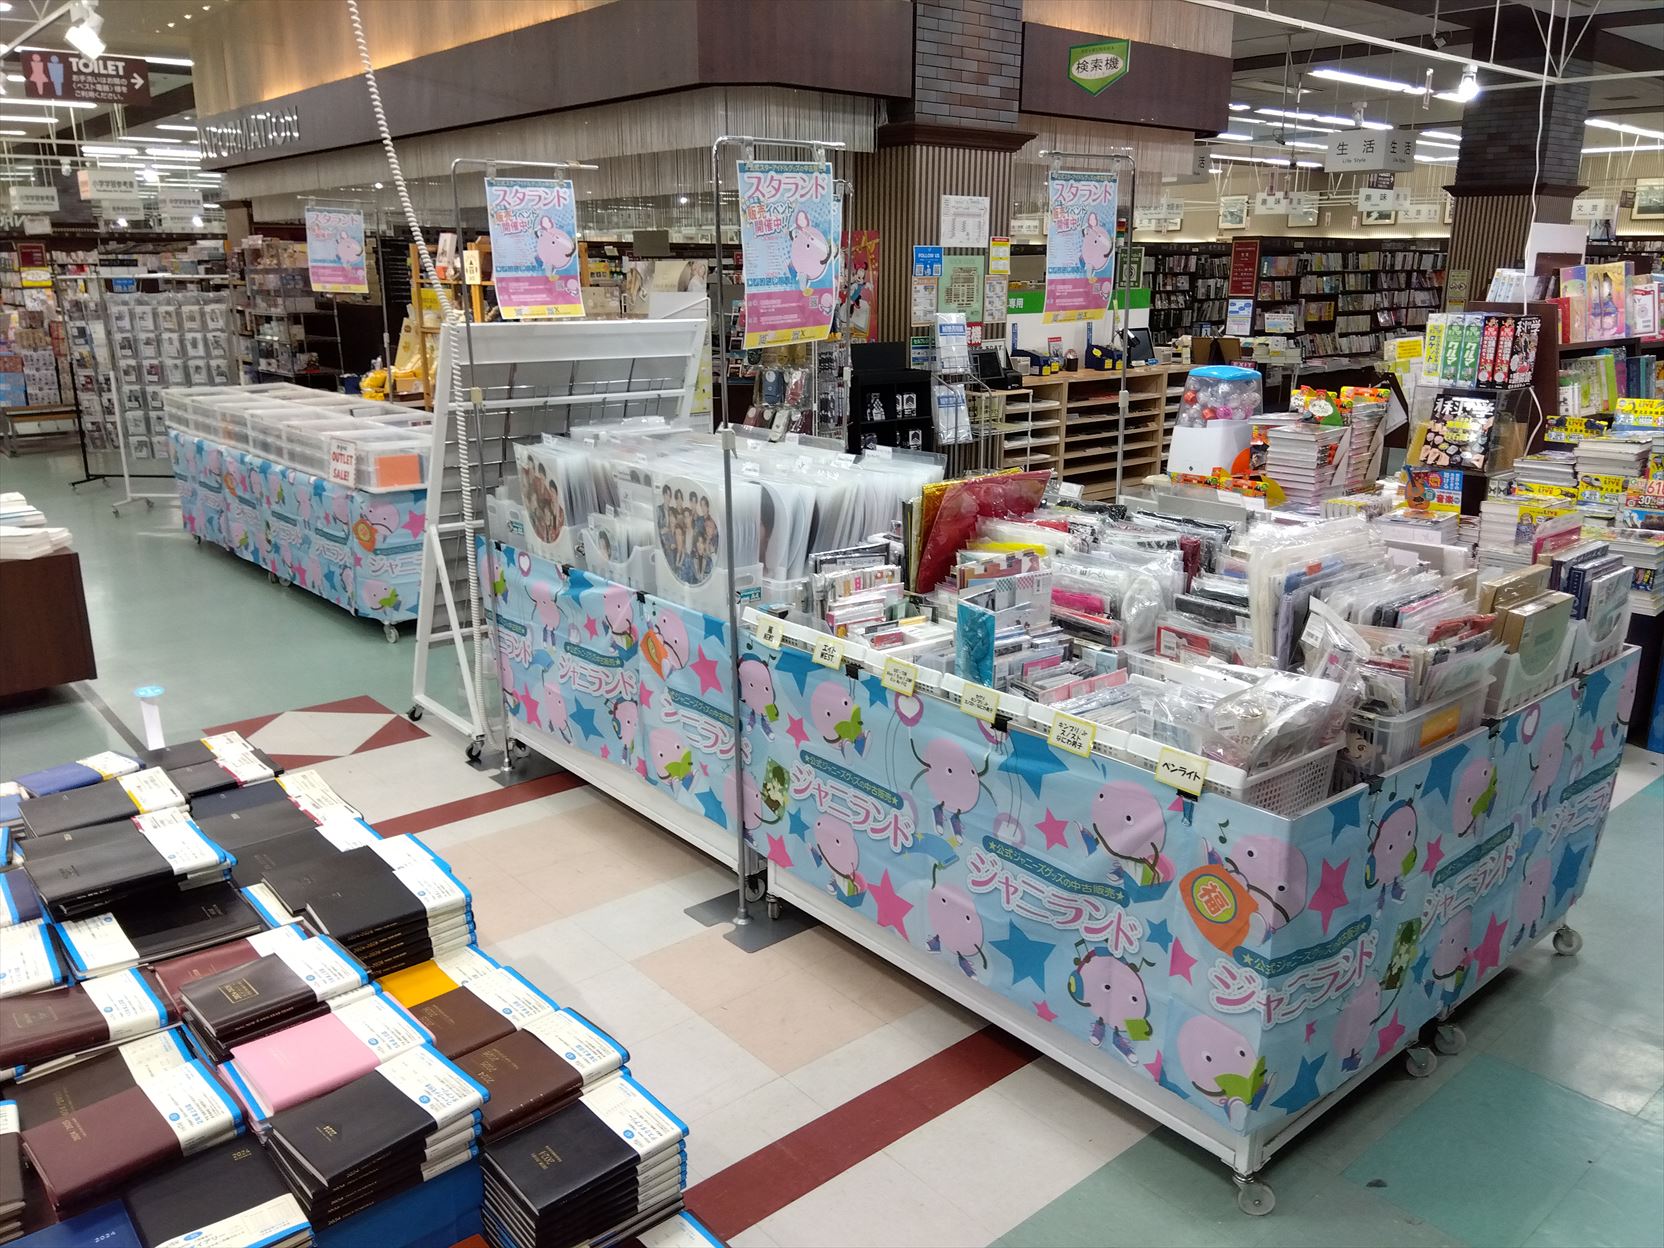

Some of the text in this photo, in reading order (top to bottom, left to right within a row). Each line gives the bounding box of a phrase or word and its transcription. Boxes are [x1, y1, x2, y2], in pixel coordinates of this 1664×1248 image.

[69, 57, 125, 76] TOILET
[1075, 56, 1120, 73] 検索機
[1336, 139, 1375, 156] 生活
[746, 174, 827, 200] スタランド
[1055, 182, 1113, 204] スタランド
[494, 188, 568, 208] スタランド
[1433, 396, 1495, 417] 科学
[331, 451, 354, 466] OUTLET
[333, 467, 350, 481] SALE!
[1537, 487, 1553, 495] LIVE
[763, 632, 775, 642] NEWS
[820, 651, 835, 662] WEST
[822, 643, 837, 654] エイト
[559, 654, 637, 699] ジャニランド
[1056, 734, 1083, 750] なにわ男子
[1162, 761, 1201, 782] ペンライト
[792, 762, 913, 850] ジャニランド
[996, 844, 1116, 899] 公式ジャニーズグッズの中古販売
[1421, 839, 1519, 934] ジャニランド
[968, 850, 1141, 954] ジャニランド
[1198, 881, 1232, 918] 福
[1211, 931, 1377, 1028] ジャニランド
[232, 1149, 250, 1159] 2024
[95, 1230, 117, 1243] 2024
